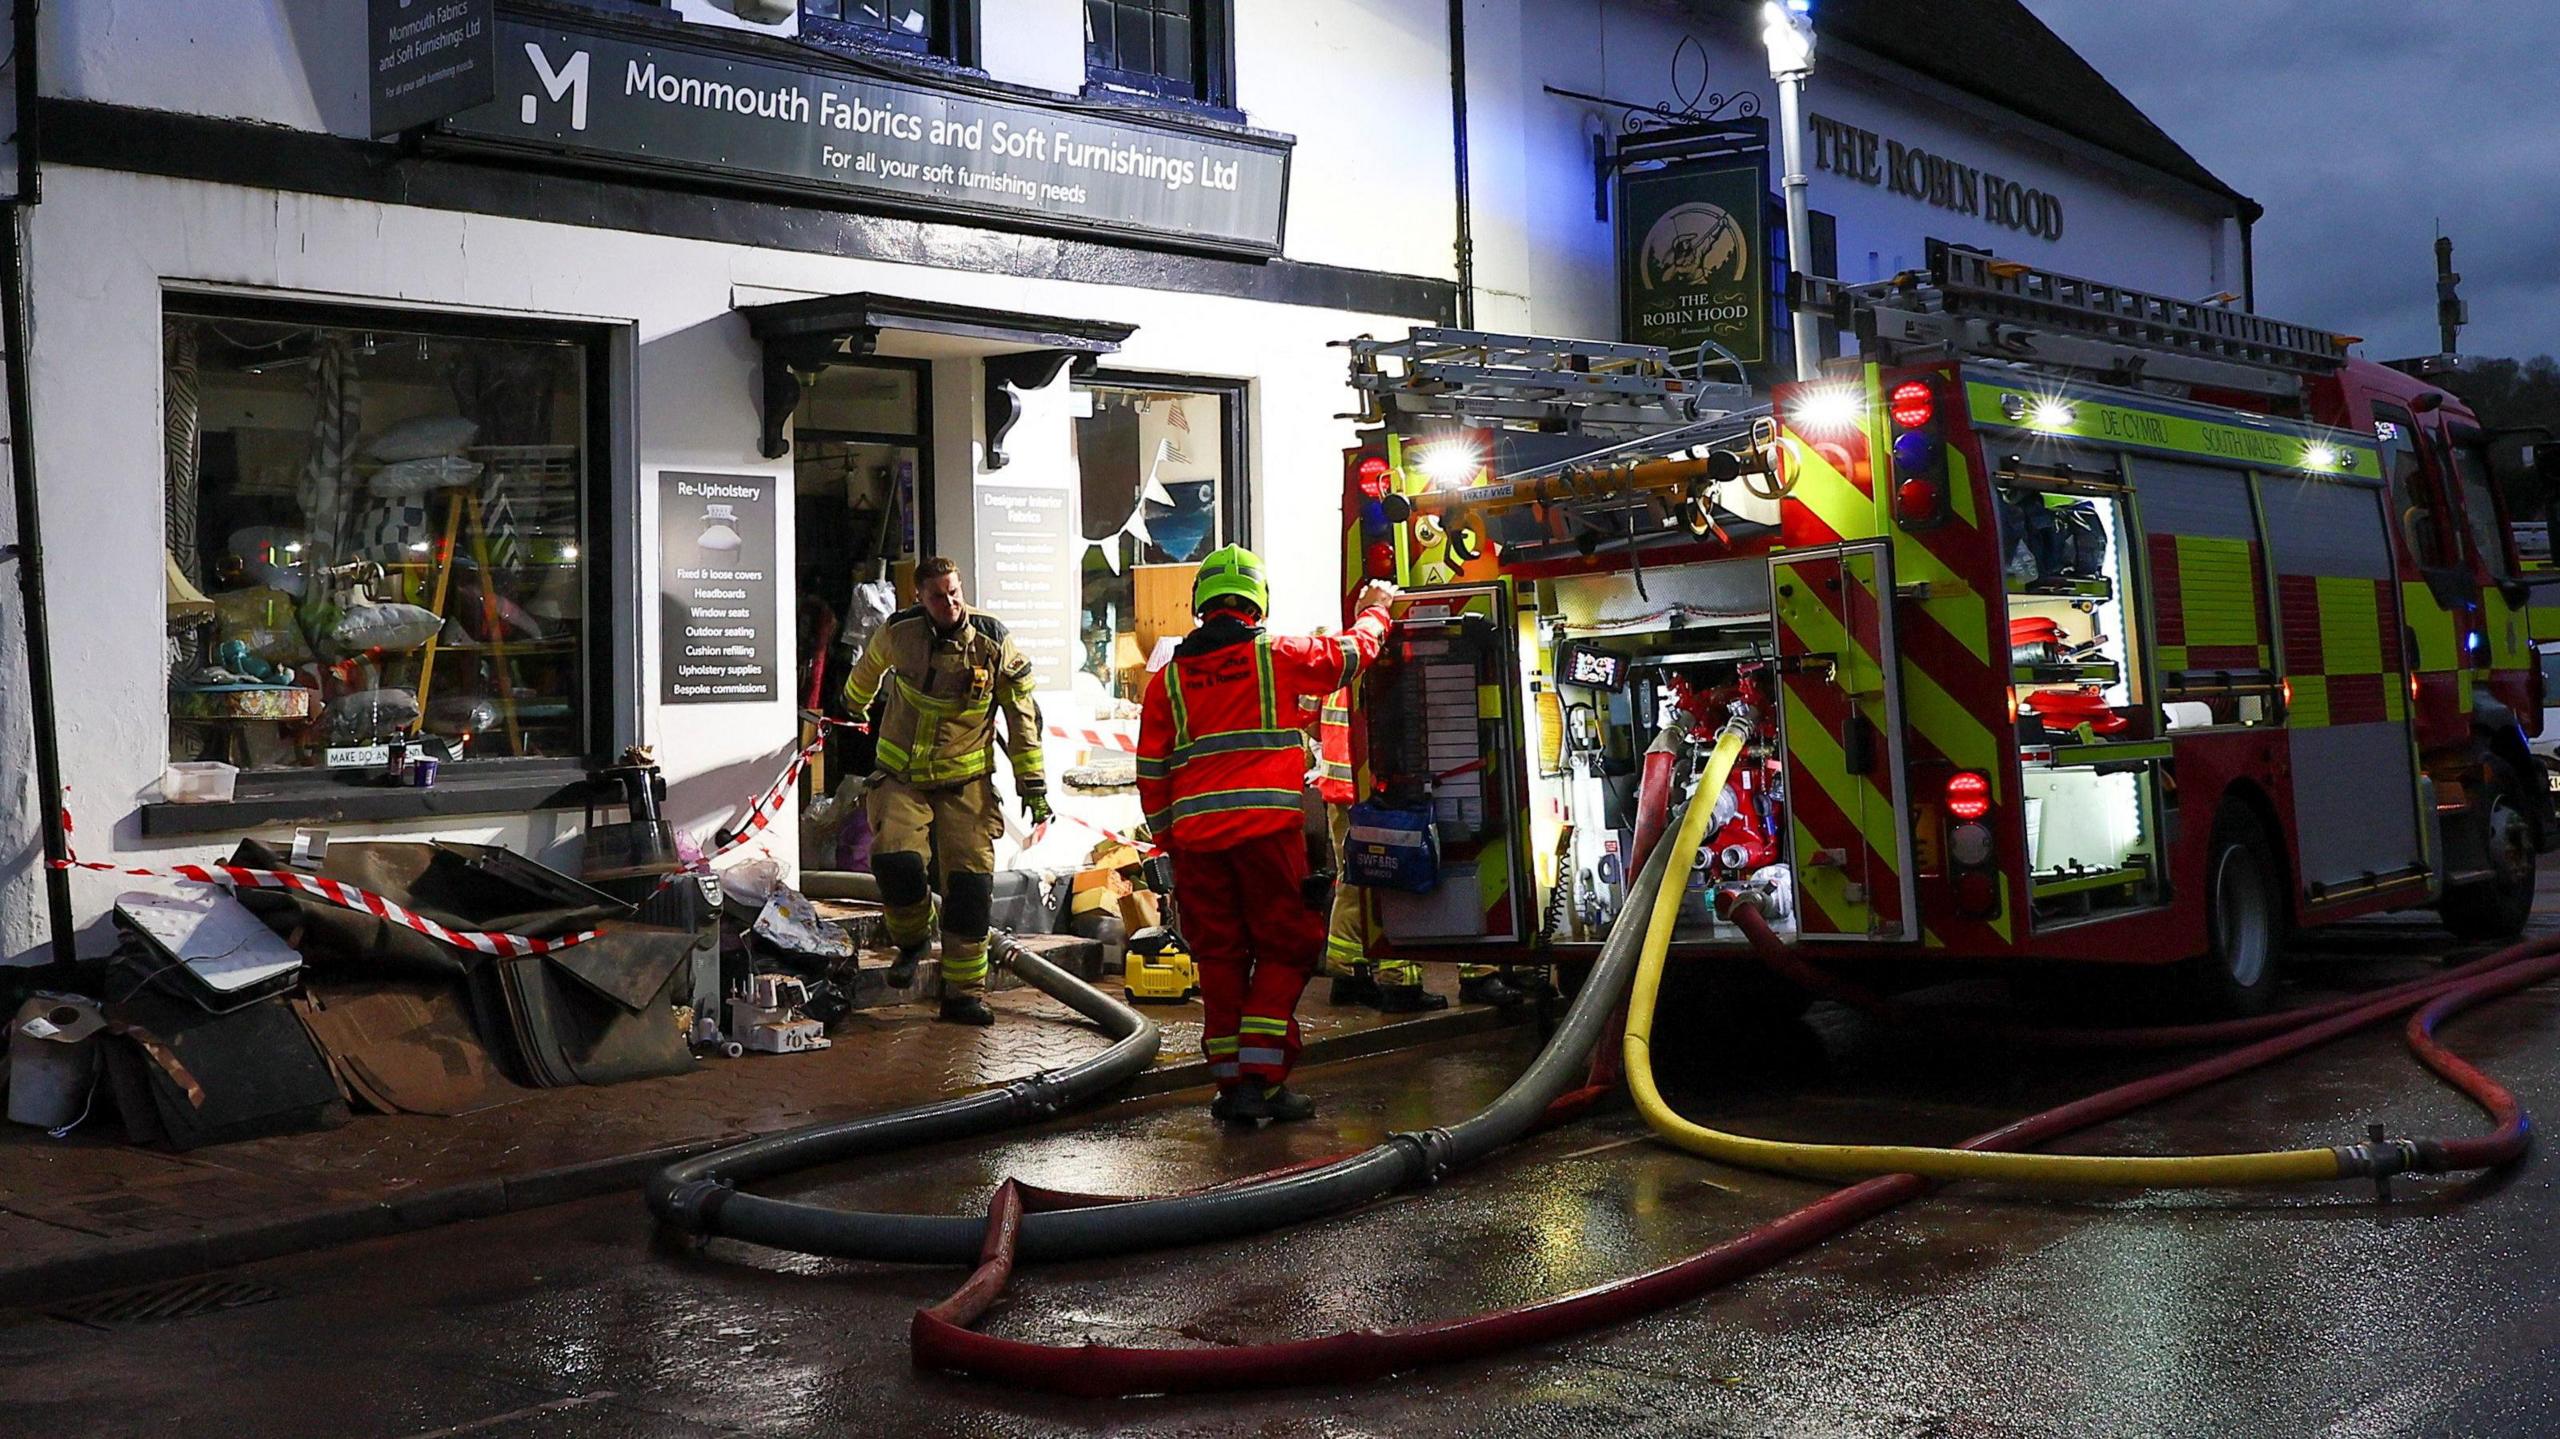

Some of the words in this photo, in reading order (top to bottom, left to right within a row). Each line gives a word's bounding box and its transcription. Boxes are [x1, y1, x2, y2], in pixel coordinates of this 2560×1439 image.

[389, 11, 435, 42] Monmouth
[437, 1, 468, 24] Fabrics
[379, 52, 395, 72] and
[396, 44, 413, 65] Soft
[415, 27, 464, 58] Furnishings
[466, 17, 481, 38] Ltd
[625, 60, 809, 123] Monmouth
[819, 93, 921, 140] Fabrics
[928, 119, 983, 151] and
[991, 121, 1046, 163] Soft
[1054, 132, 1194, 190] Furnishings
[1202, 156, 1238, 191] Ltd
[823, 145, 851, 169] For
[854, 152, 876, 173] all
[879, 159, 919, 185] your
[922, 164, 954, 186] soft
[958, 167, 1036, 201] furnishing
[1040, 181, 1086, 204] needs
[1809, 112, 1881, 185] THE
[1886, 138, 1979, 217] ROBIN
[1983, 172, 2064, 241] HOOD
[1679, 294, 1709, 307] THE
[1643, 311, 1693, 326] ROBIN
[1697, 305, 1749, 321] HOOD
[2101, 409, 2121, 436] DE
[2123, 414, 2168, 445] CYMRU
[2201, 426, 2243, 456] SOUTH
[2244, 433, 2283, 462] WALES
[678, 482, 760, 501] Re-Upholstery
[677, 568, 700, 580] Fixed
[701, 569, 708, 580] &
[710, 569, 733, 580] loose
[734, 571, 762, 580] covers
[694, 588, 746, 599] Headboards
[690, 607, 726, 618] Window
[728, 608, 749, 618] seats
[685, 627, 723, 637] Outdoor
[725, 627, 755, 639] seating
[685, 645, 721, 656] Cushion
[722, 645, 755, 658] refilling
[678, 664, 726, 678] Upholstery
[727, 664, 762, 677] supplies
[674, 684, 710, 697] Bespoke
[712, 683, 766, 695] commissions
[330, 751, 355, 763] MAKE
[359, 751, 372, 761] DO
